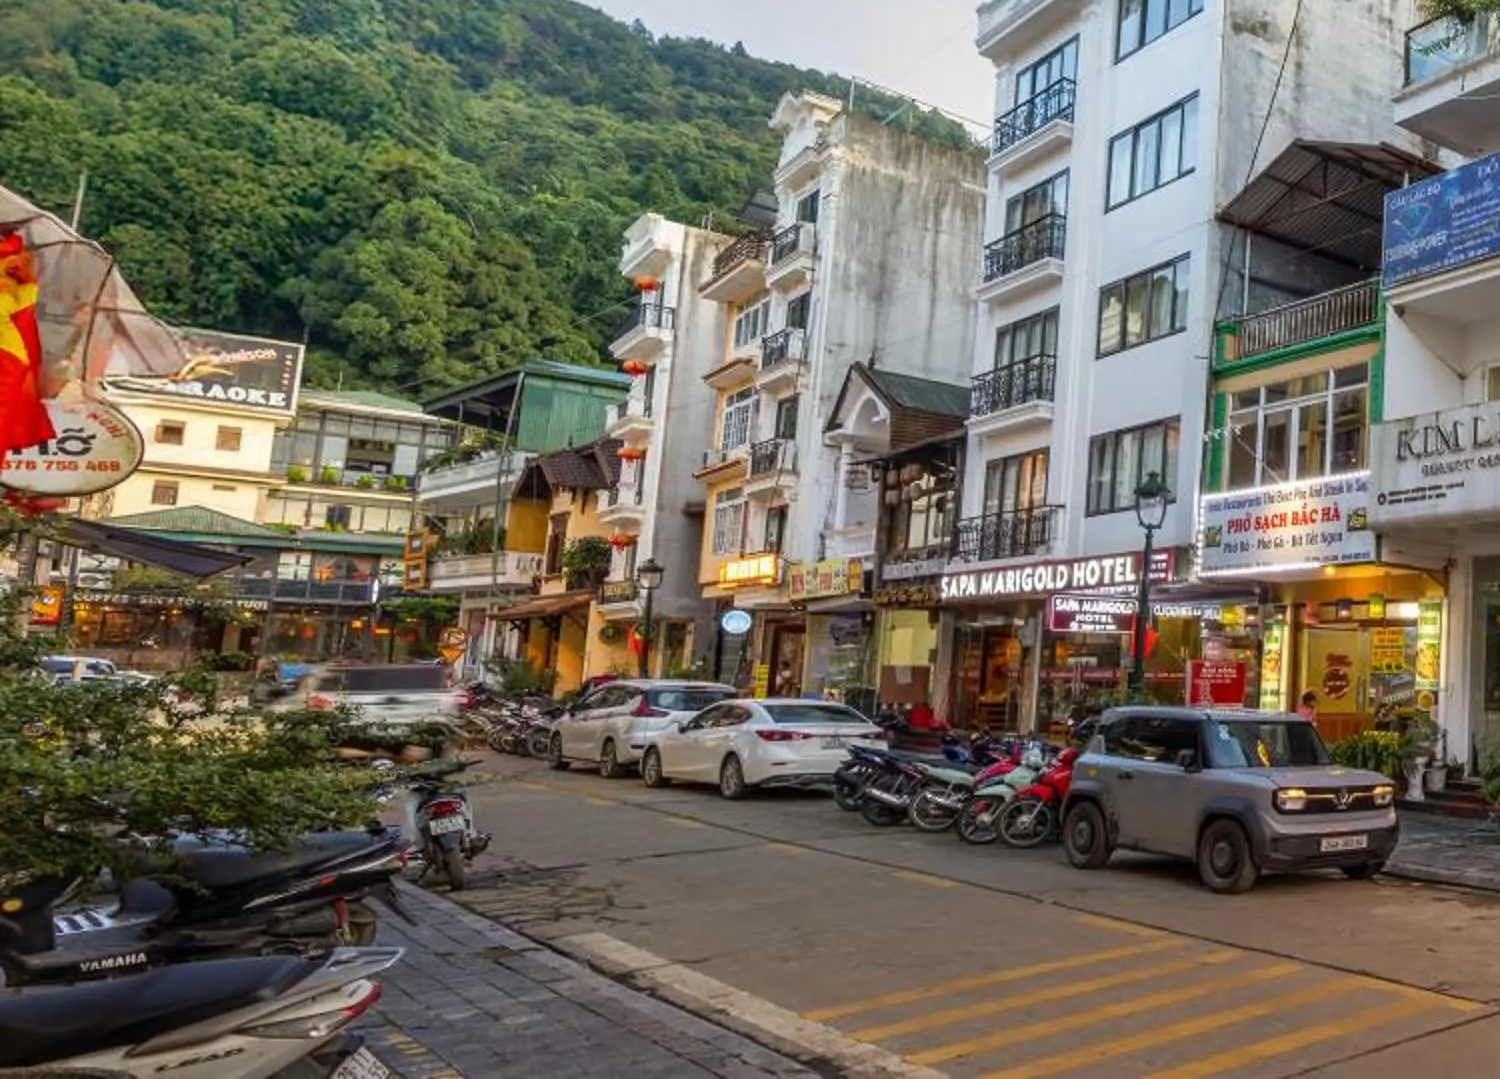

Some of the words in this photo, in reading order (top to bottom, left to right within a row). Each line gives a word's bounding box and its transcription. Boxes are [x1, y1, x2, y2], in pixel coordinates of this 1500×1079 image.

[1397, 420, 1466, 461] KIM
[1254, 512, 1286, 533] SẠCH
[1321, 502, 1341, 522] HÀ
[940, 576, 977, 597] SAPA
[981, 566, 1067, 595] MARIGOLD
[1073, 556, 1137, 587] HOTEL
[1056, 599, 1079, 611] SAPA
[1075, 614, 1113, 624] HOTEL
[80, 952, 147, 972] YAMAHA
